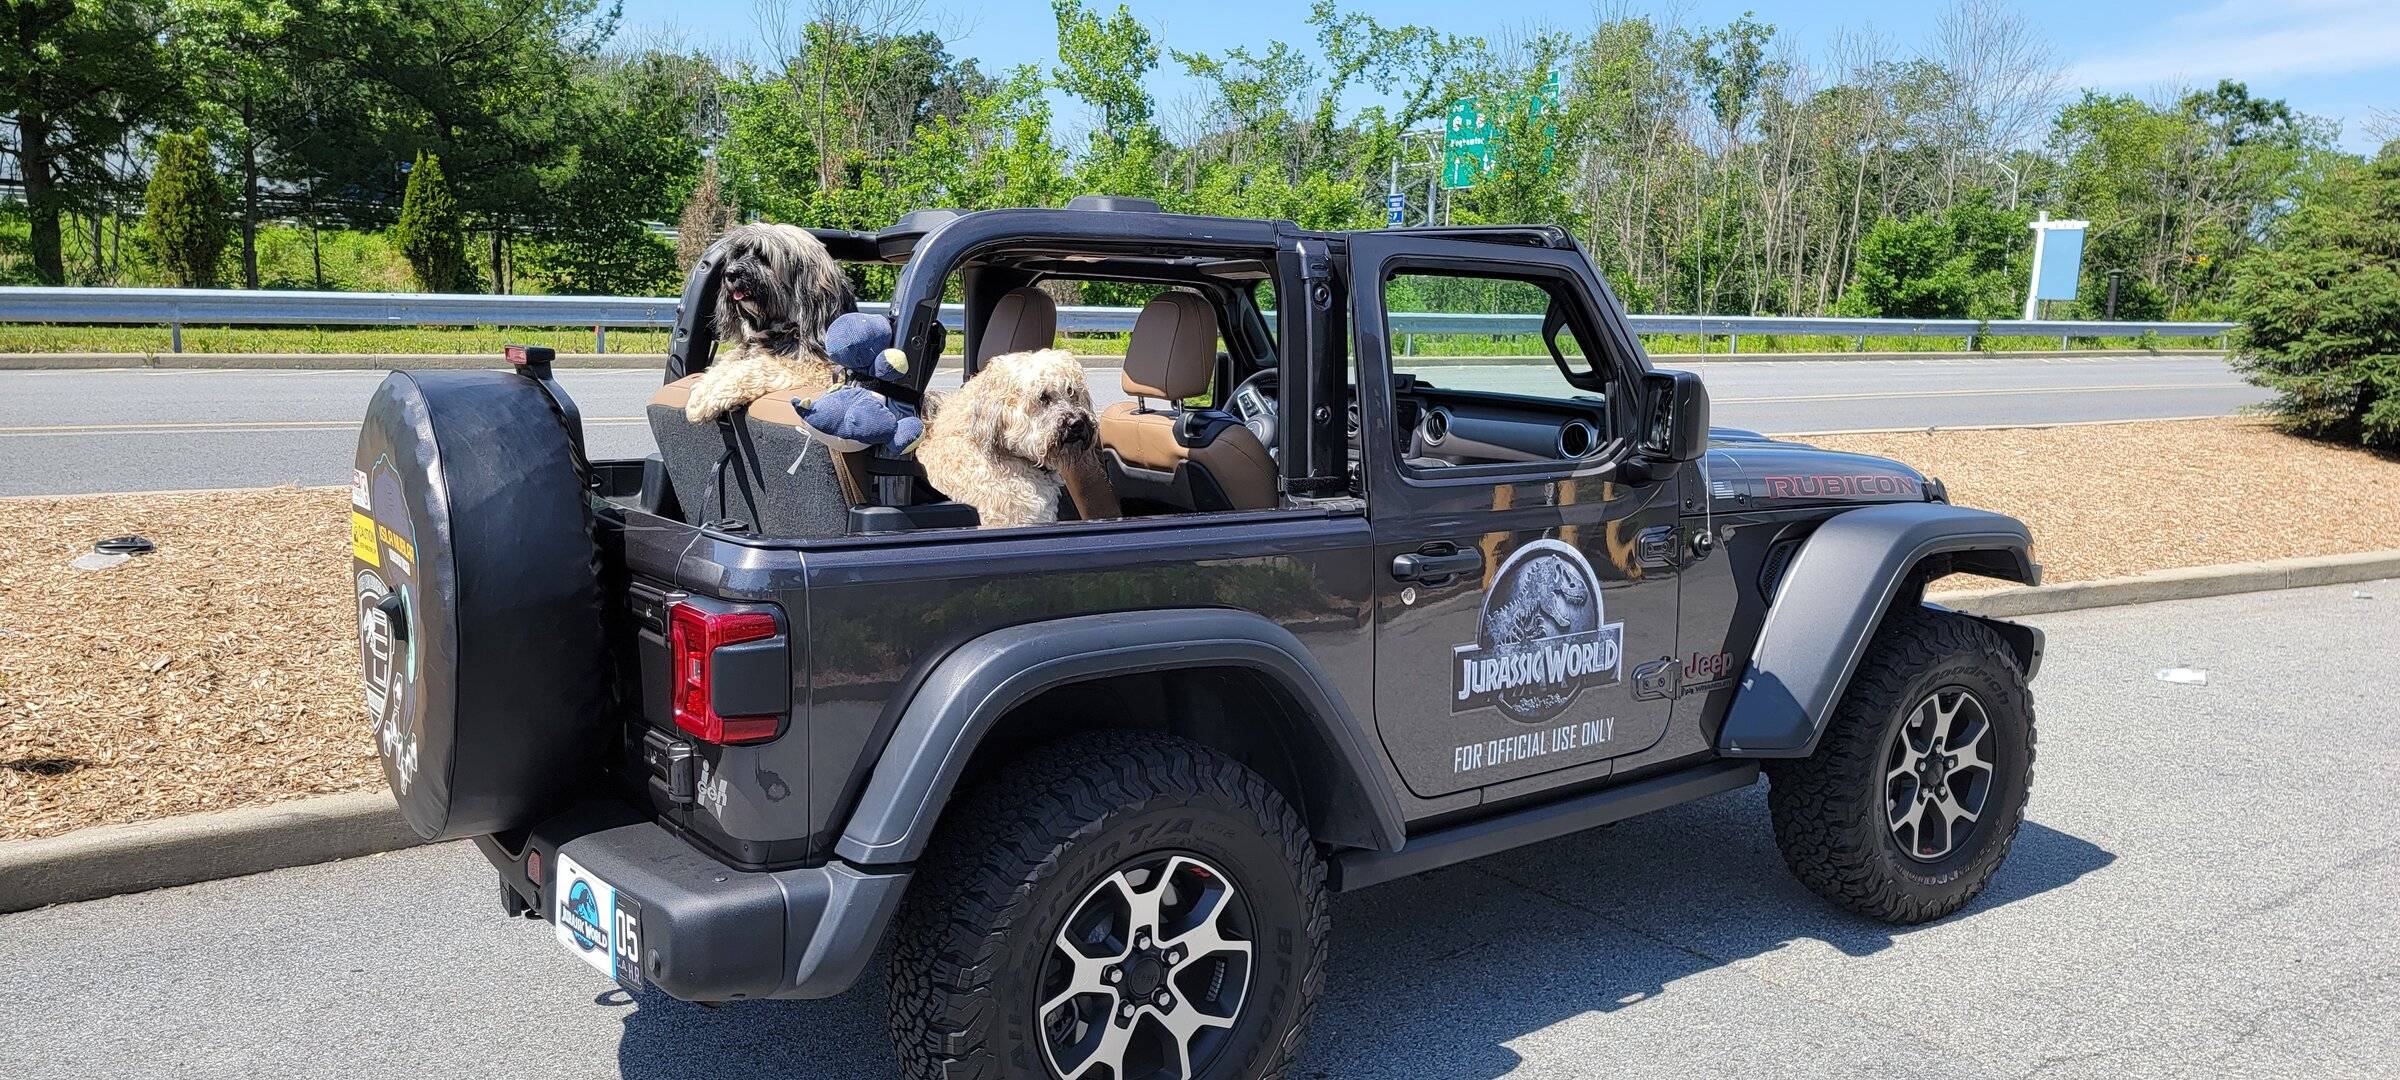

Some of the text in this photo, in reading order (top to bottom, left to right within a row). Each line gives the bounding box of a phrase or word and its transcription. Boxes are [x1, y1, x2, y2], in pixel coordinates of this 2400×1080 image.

[1765, 475, 1920, 499] RUBICON
[1458, 638, 1619, 700] JURASSIC WORLD
[1684, 651, 1734, 679] Jeep
[1454, 717, 1615, 774] FOR OFFICIAL USE ONLY
[615, 908, 639, 963] 05
